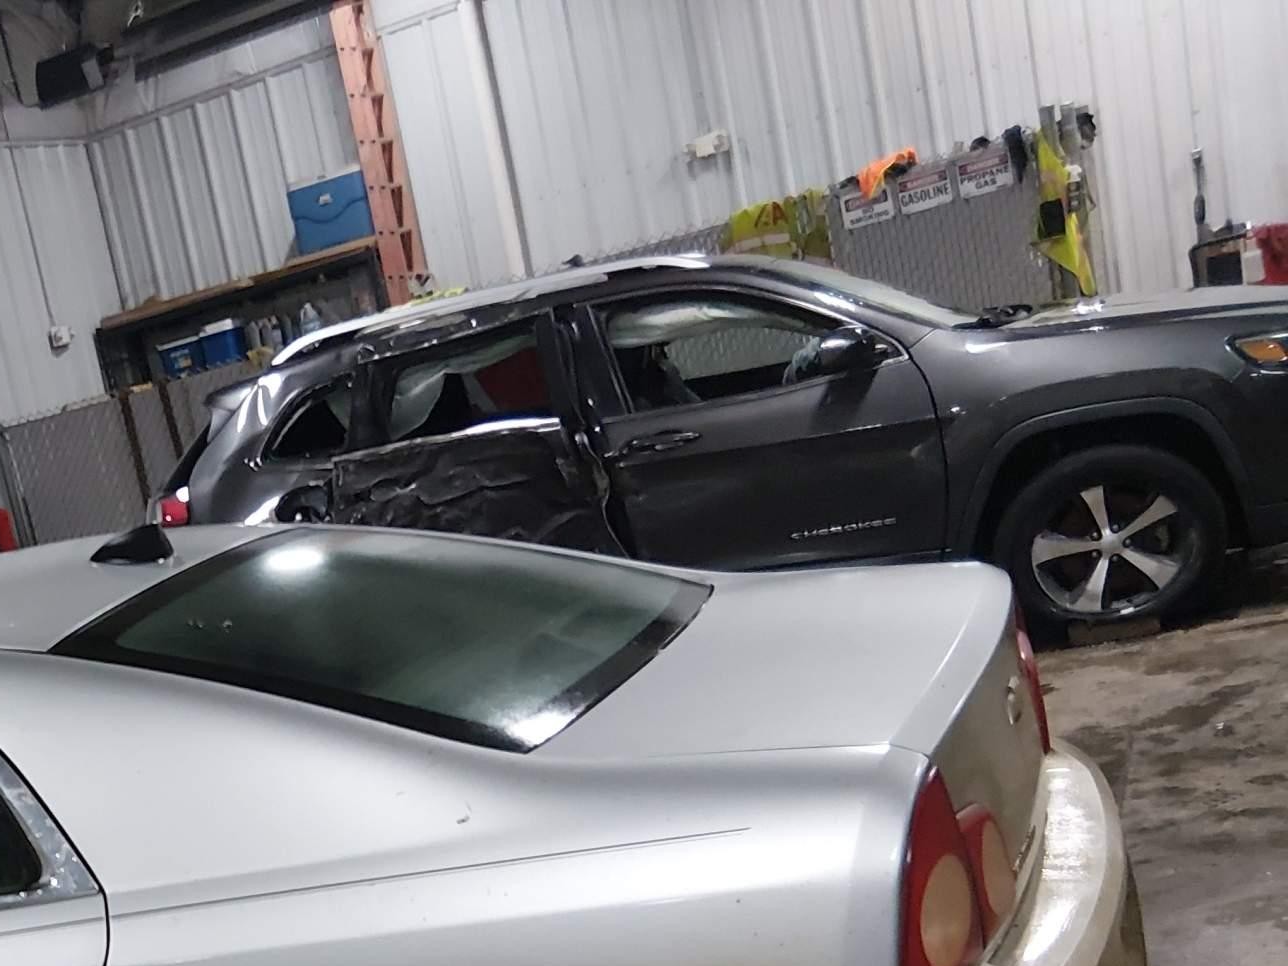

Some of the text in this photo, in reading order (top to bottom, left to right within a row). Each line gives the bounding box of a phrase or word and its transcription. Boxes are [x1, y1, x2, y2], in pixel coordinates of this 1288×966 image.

[959, 165, 1010, 186] PROPANE
[975, 178, 998, 190] GAS
[900, 182, 950, 208] GASOLINE
[791, 517, 896, 540] CHEROKEE
